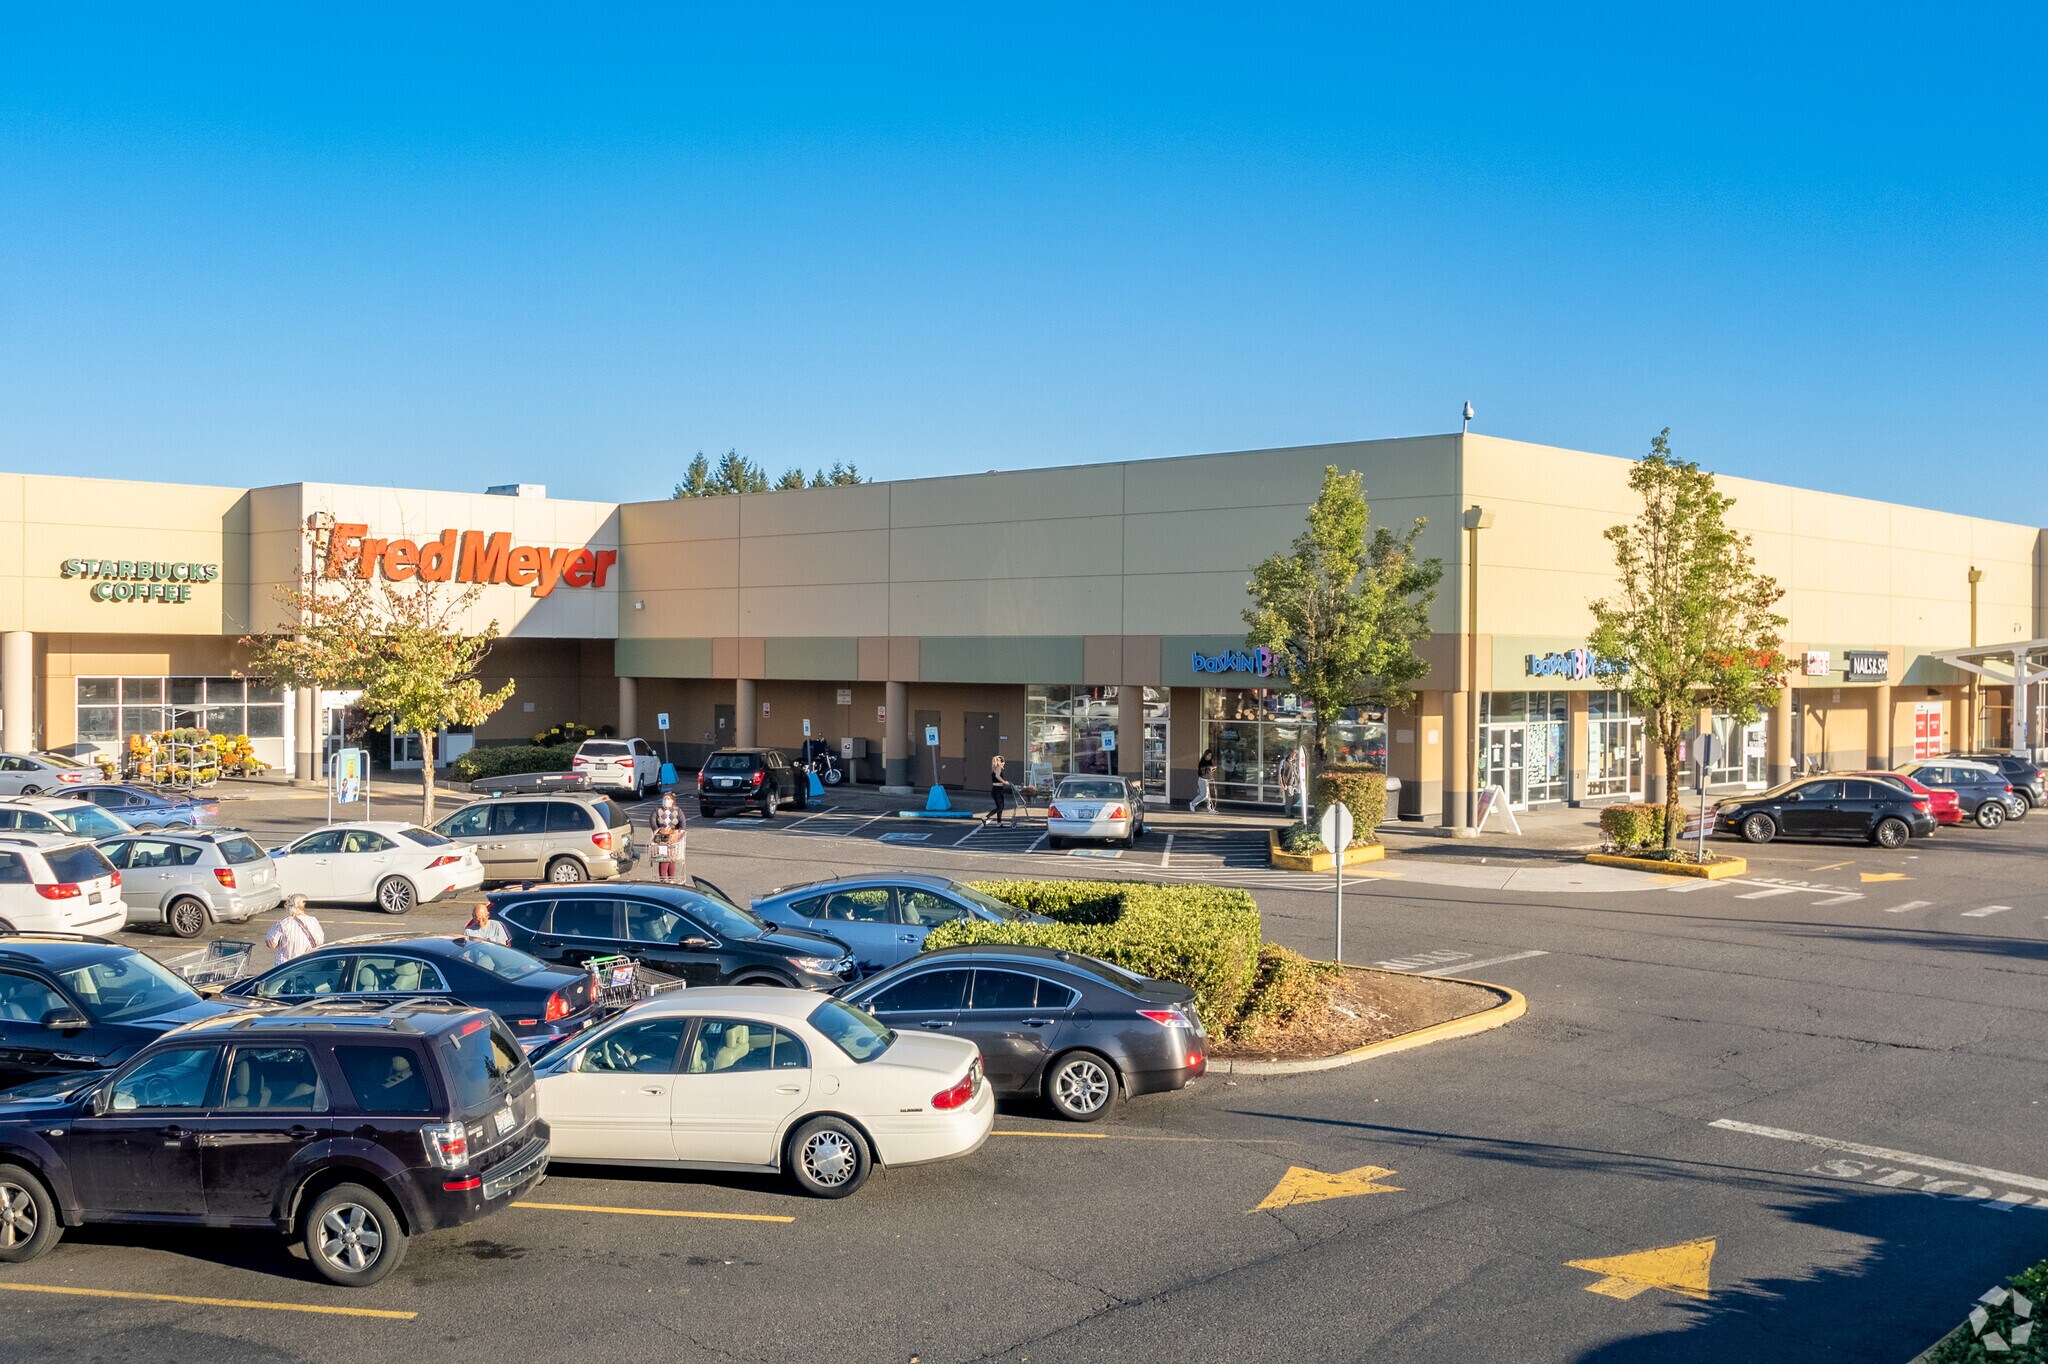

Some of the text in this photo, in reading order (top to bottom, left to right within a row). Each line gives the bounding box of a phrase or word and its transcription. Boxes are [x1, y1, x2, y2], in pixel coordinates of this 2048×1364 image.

[65, 558, 220, 582] STARBUCKS
[327, 523, 618, 598] Fred Meyer
[95, 581, 192, 602] COFFEE
[1191, 649, 1255, 674] baskin
[1853, 657, 1873, 675] NAILS
